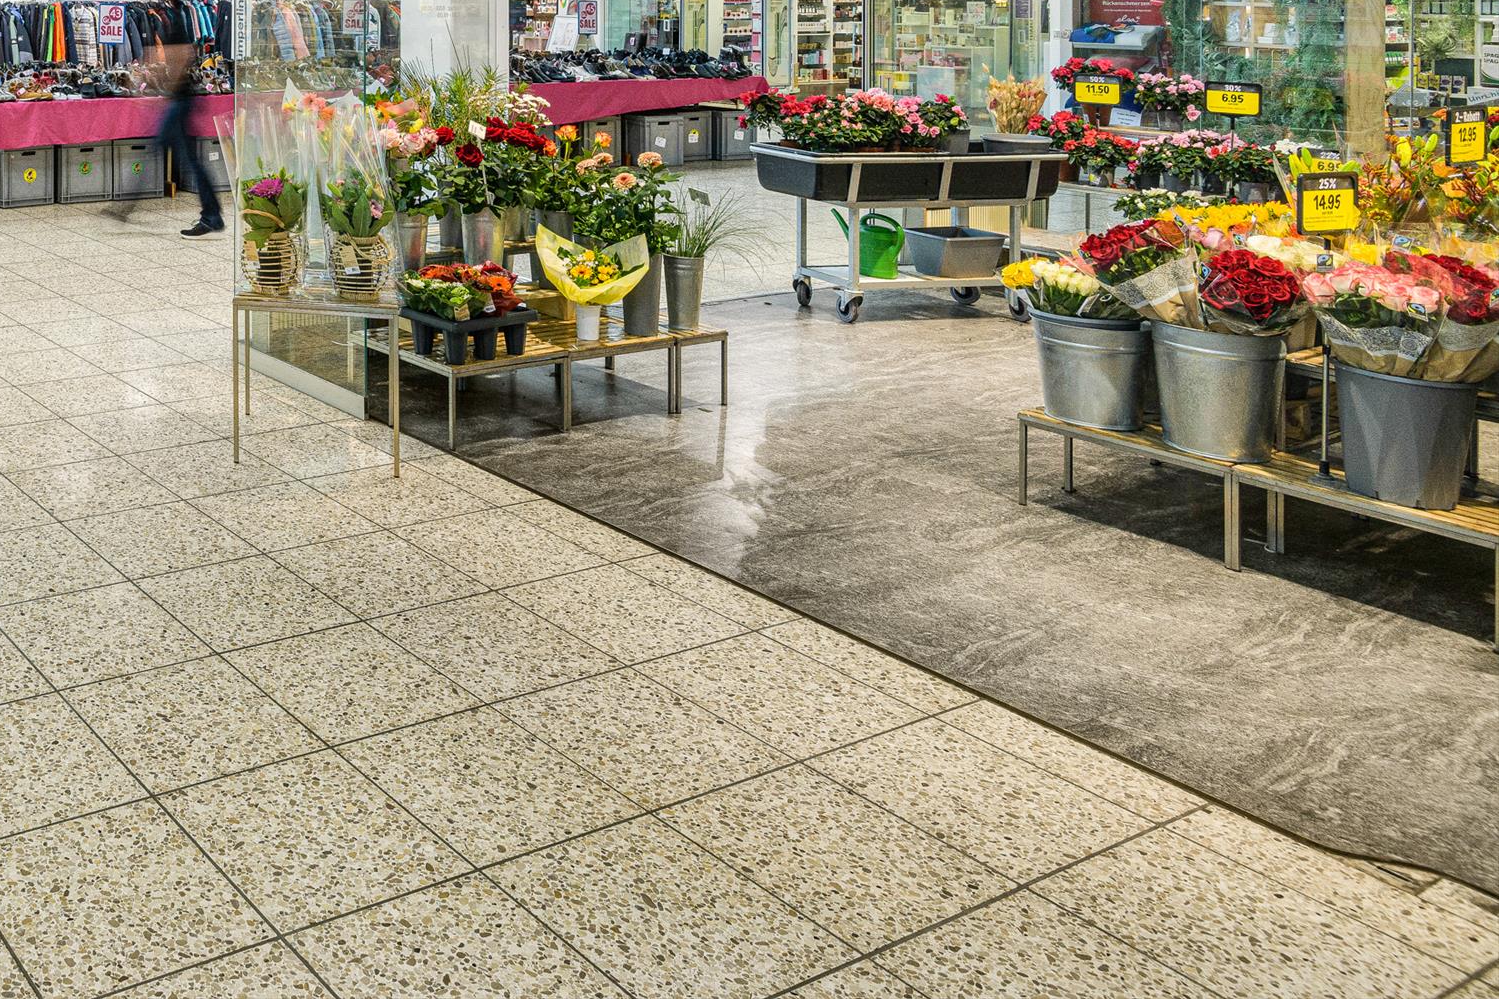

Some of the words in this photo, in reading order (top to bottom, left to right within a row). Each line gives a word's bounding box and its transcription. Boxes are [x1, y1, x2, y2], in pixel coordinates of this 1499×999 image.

[580, 19, 596, 29] SALE
[100, 25, 122, 37] SALE
[1085, 84, 1110, 94] 11.50
[1221, 93, 1244, 103] 6.95
[1458, 127, 1477, 142] 12.95
[1318, 178, 1337, 189] 25%
[1313, 194, 1341, 210] 14.95
